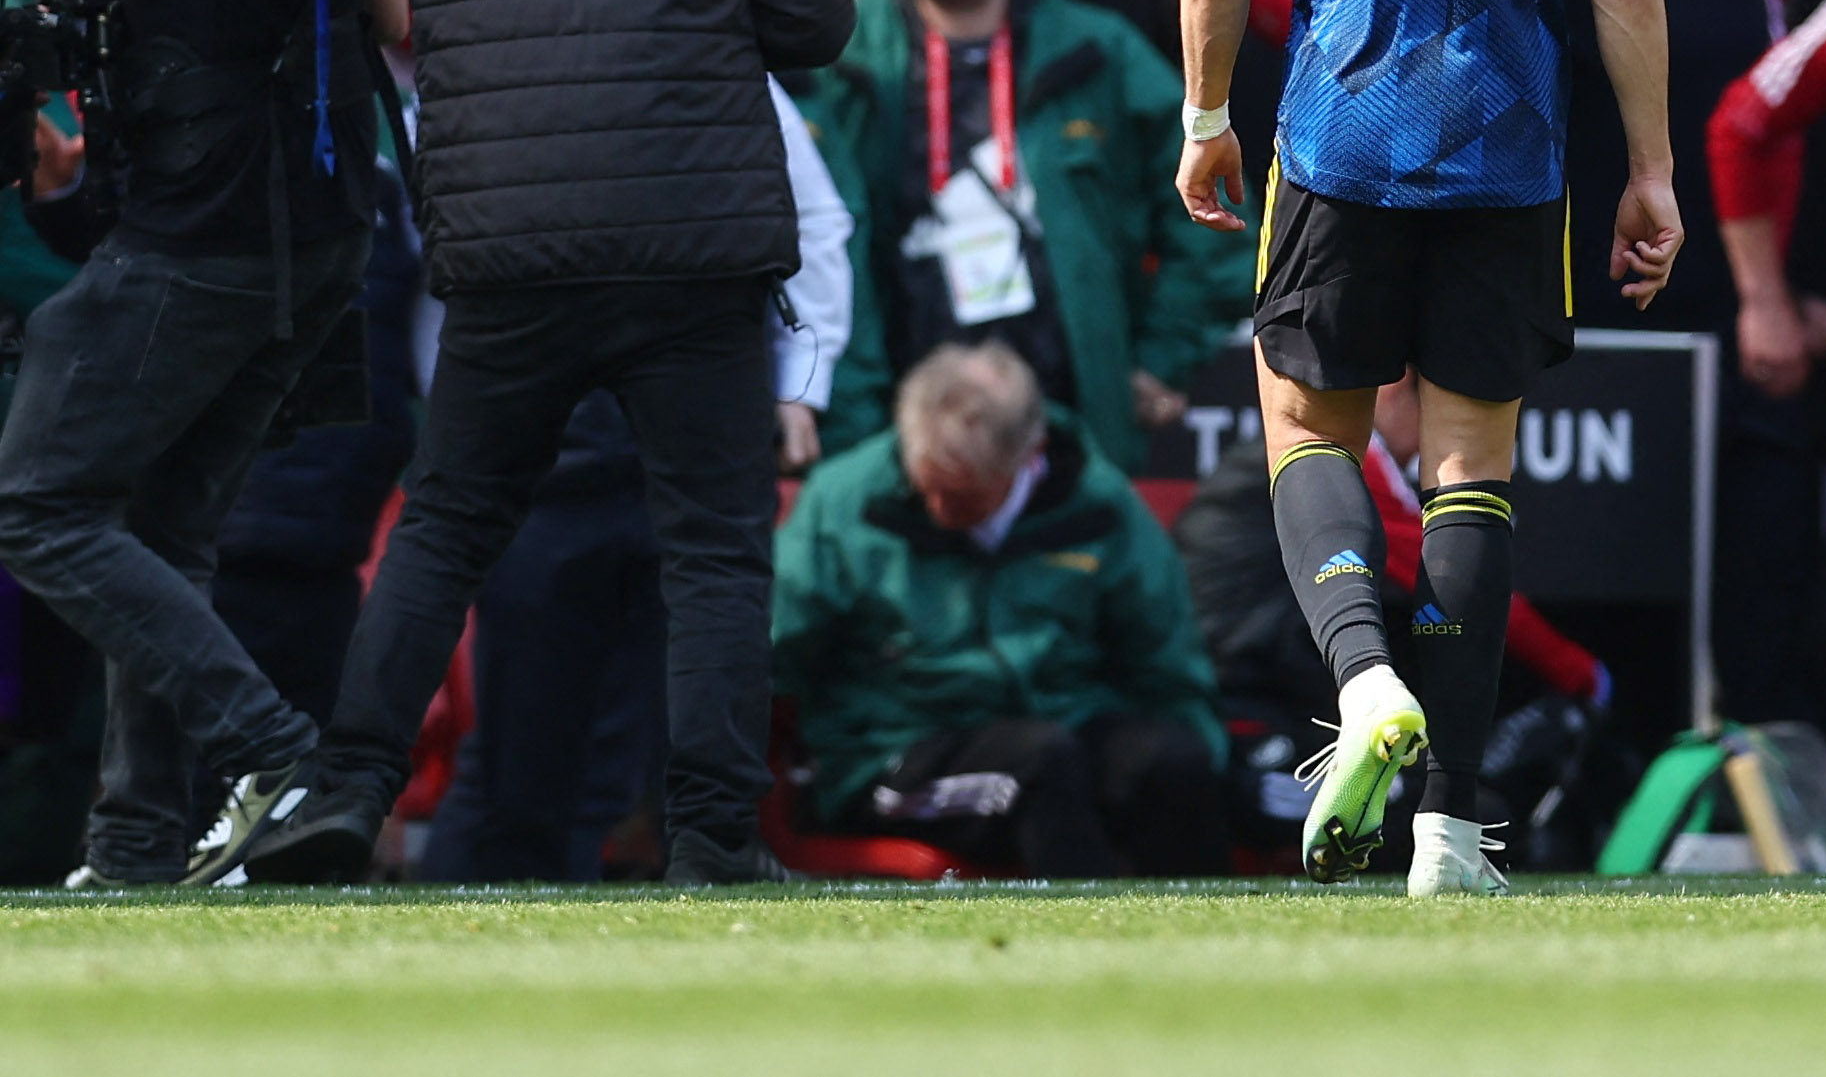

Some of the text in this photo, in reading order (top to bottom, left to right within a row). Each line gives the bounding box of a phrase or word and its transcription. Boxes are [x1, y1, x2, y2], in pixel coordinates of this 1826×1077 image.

[1512, 408, 1633, 482] UN
[1314, 562, 1374, 585] adidas
[1412, 621, 1463, 636] didas
